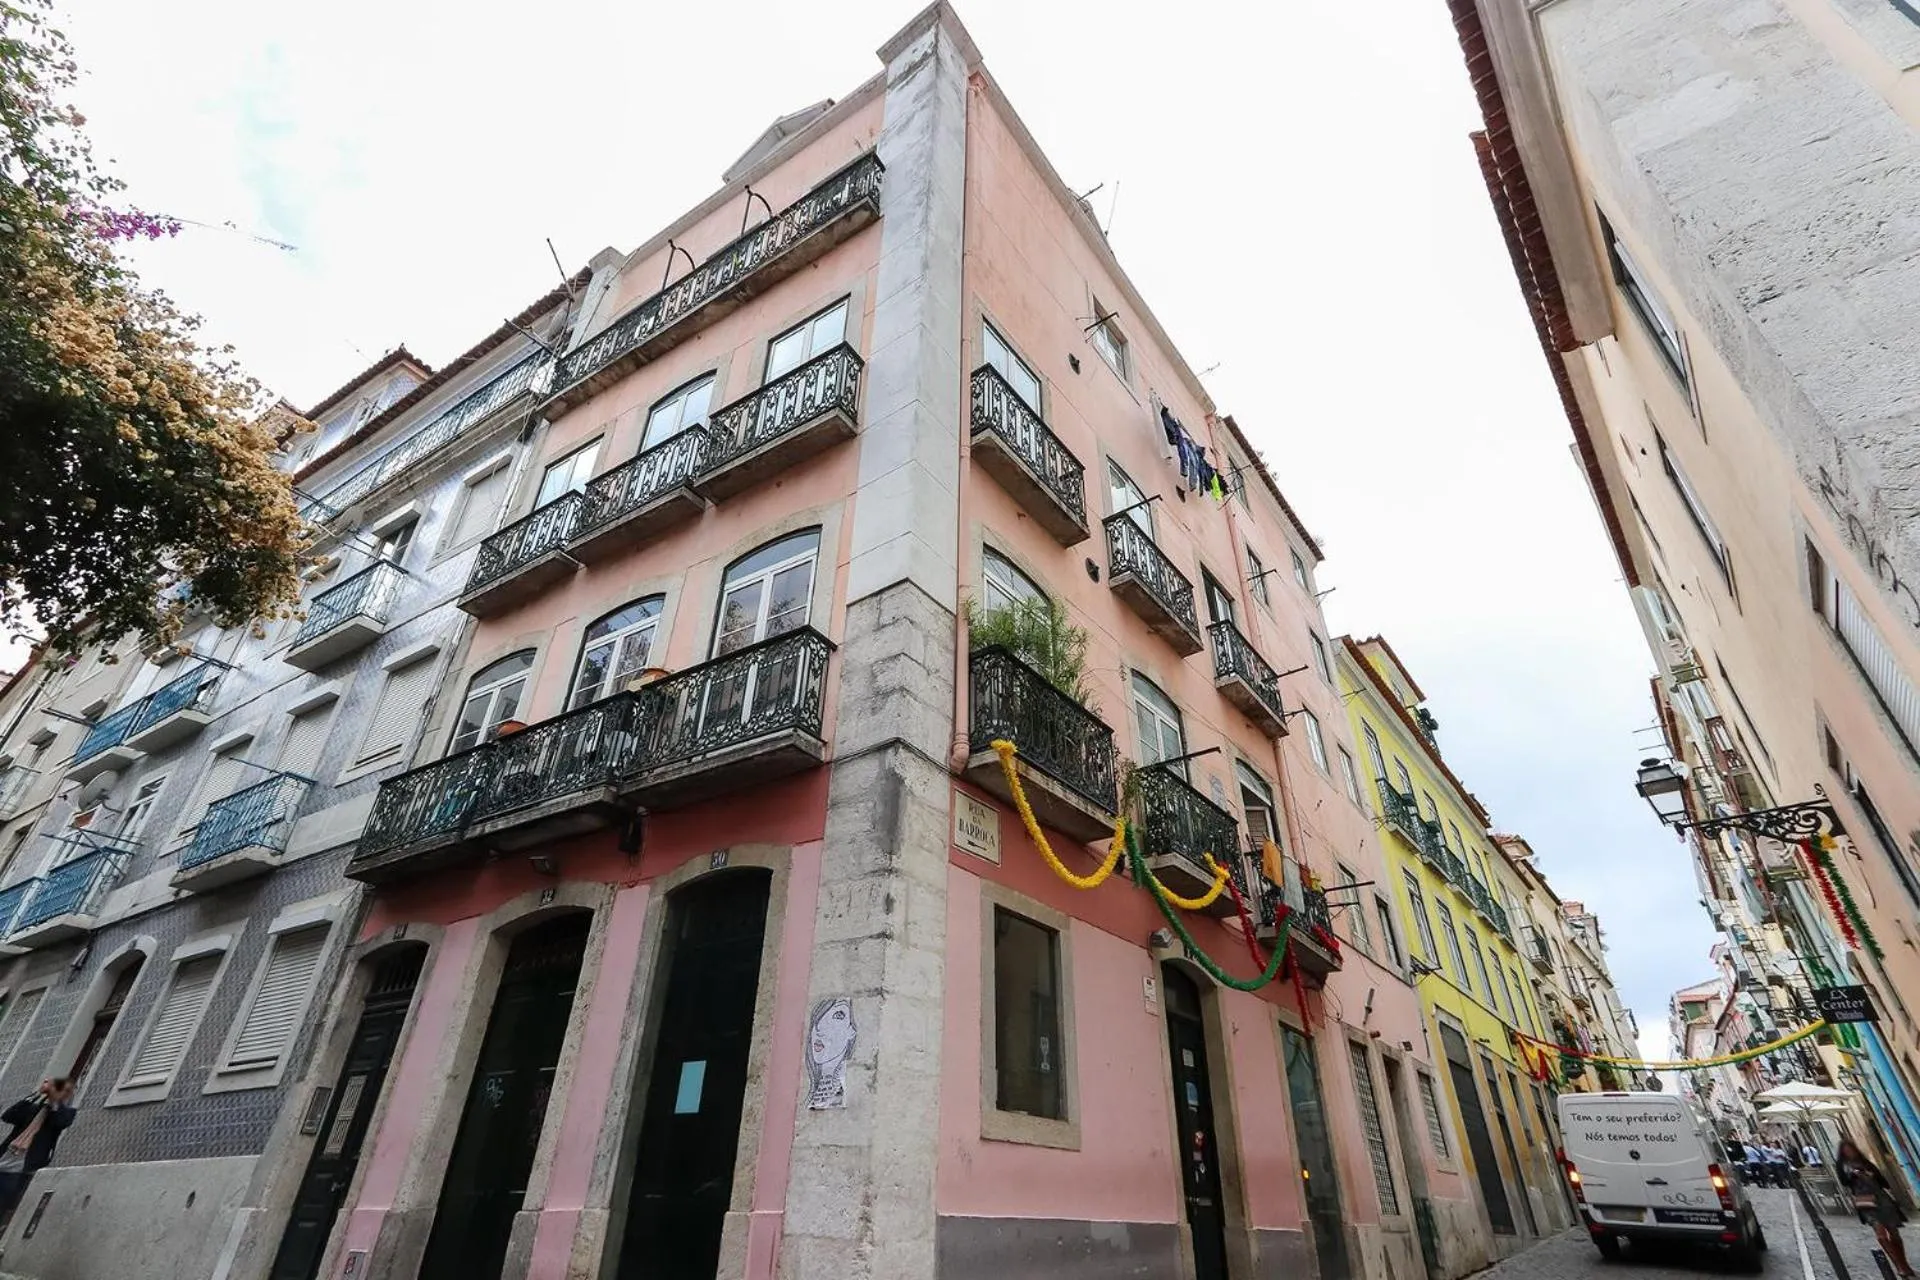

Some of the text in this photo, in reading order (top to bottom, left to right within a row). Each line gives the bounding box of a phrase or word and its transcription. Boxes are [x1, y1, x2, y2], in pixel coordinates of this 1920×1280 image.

[969, 803, 985, 818] RUA
[1821, 999, 1865, 1010] Center
[1570, 1112, 1592, 1122] Tem
[1626, 1112, 1681, 1125] preferido?
[1585, 1131, 1677, 1142] Nós temos todos!
